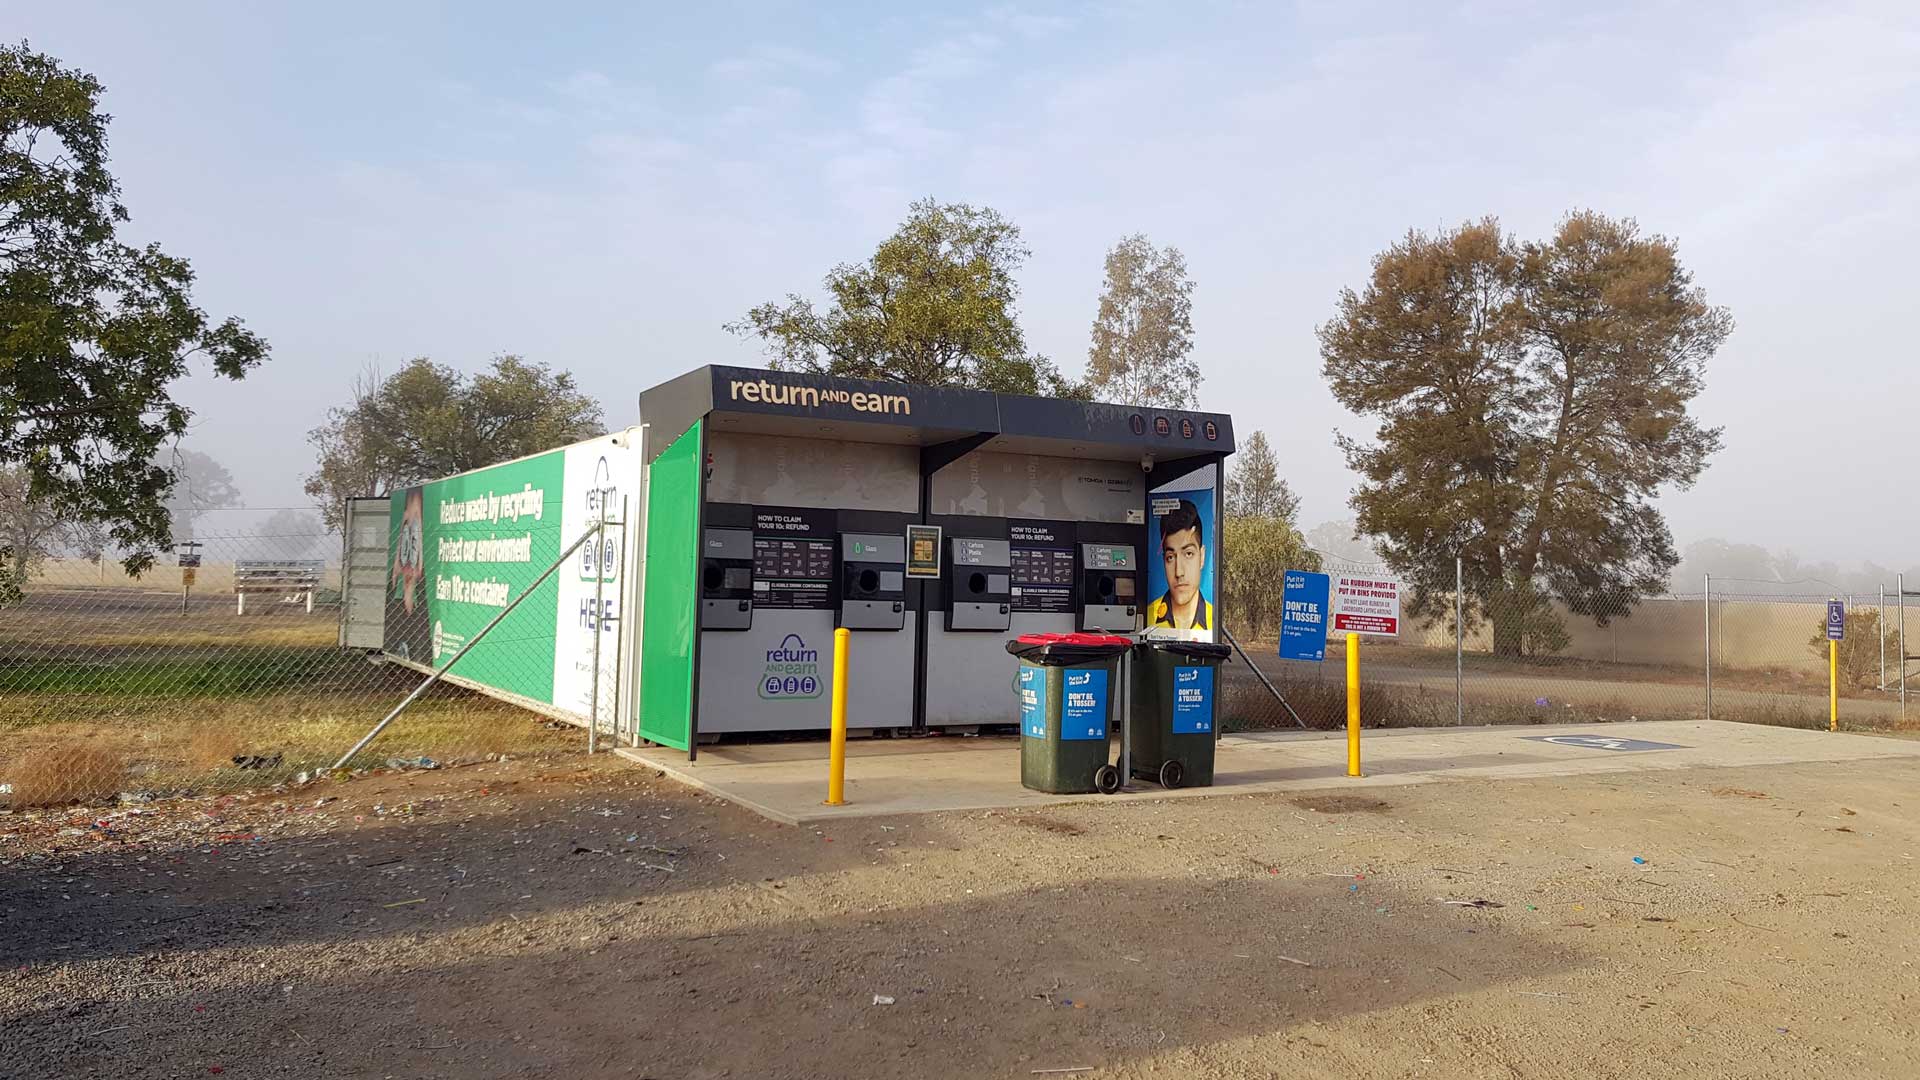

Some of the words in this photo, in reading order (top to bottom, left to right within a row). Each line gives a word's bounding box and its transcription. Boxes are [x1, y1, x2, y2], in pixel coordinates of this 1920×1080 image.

[730, 379, 820, 407] return
[820, 389, 850, 403] AND
[851, 392, 911, 415] earn
[440, 497, 465, 524] Reduce
[465, 494, 488, 522] waste
[488, 491, 500, 524] by
[500, 483, 544, 522] recycling
[438, 536, 463, 562] Protect
[463, 540, 477, 562] our
[477, 532, 531, 562] environment
[436, 574, 452, 600] Earn
[470, 576, 509, 607] container
[1350, 579, 1373, 587] RUBBISH
[1374, 581, 1388, 589] MUST
[1339, 587, 1349, 595] PUT
[1357, 589, 1369, 597] BINS
[1371, 591, 1396, 599] PROVIDED
[1285, 601, 1308, 612] DON'T
[1308, 603, 1318, 613] BE
[580, 598, 612, 632] HERE
[1284, 611, 1290, 620] A
[1291, 611, 1321, 624] TOSSER!
[767, 648, 817, 662] return
[765, 664, 784, 672] AND
[785, 663, 817, 674] earn
